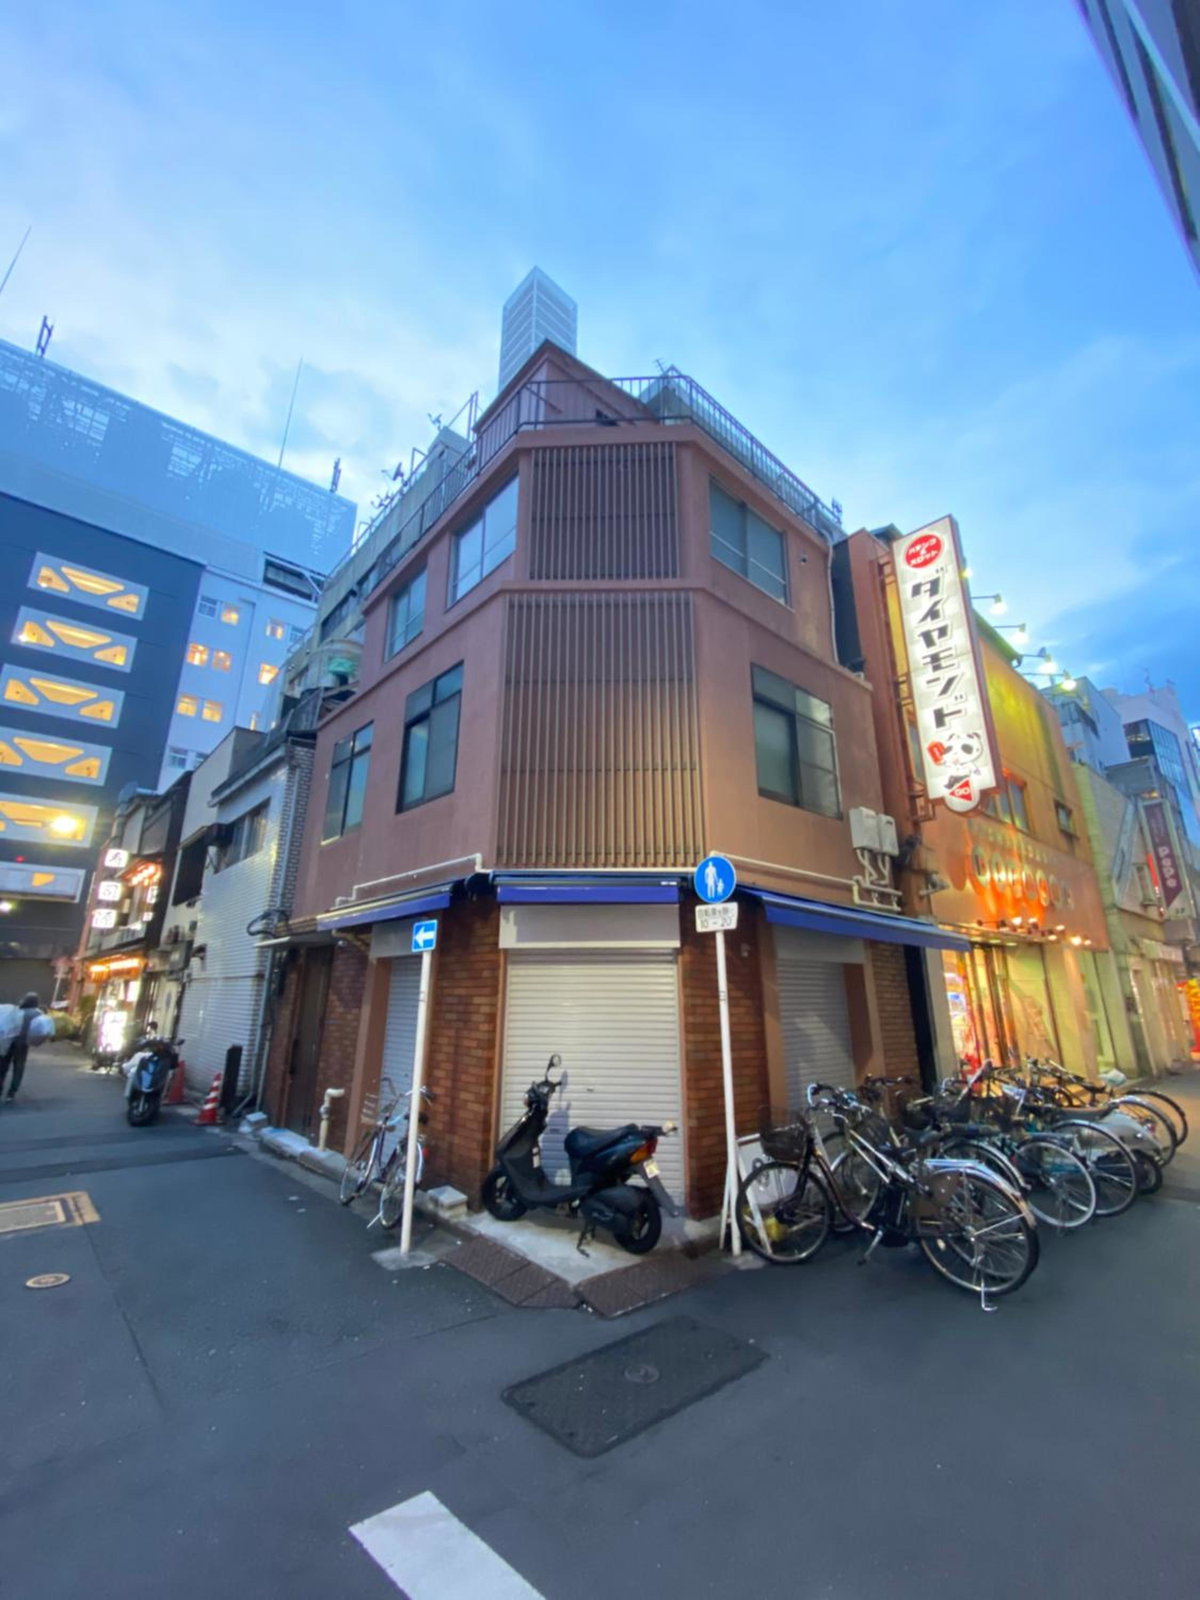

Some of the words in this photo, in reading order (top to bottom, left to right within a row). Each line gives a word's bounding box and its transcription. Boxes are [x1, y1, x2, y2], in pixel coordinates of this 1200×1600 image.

[910, 567, 964, 729] ダイヤモンド
